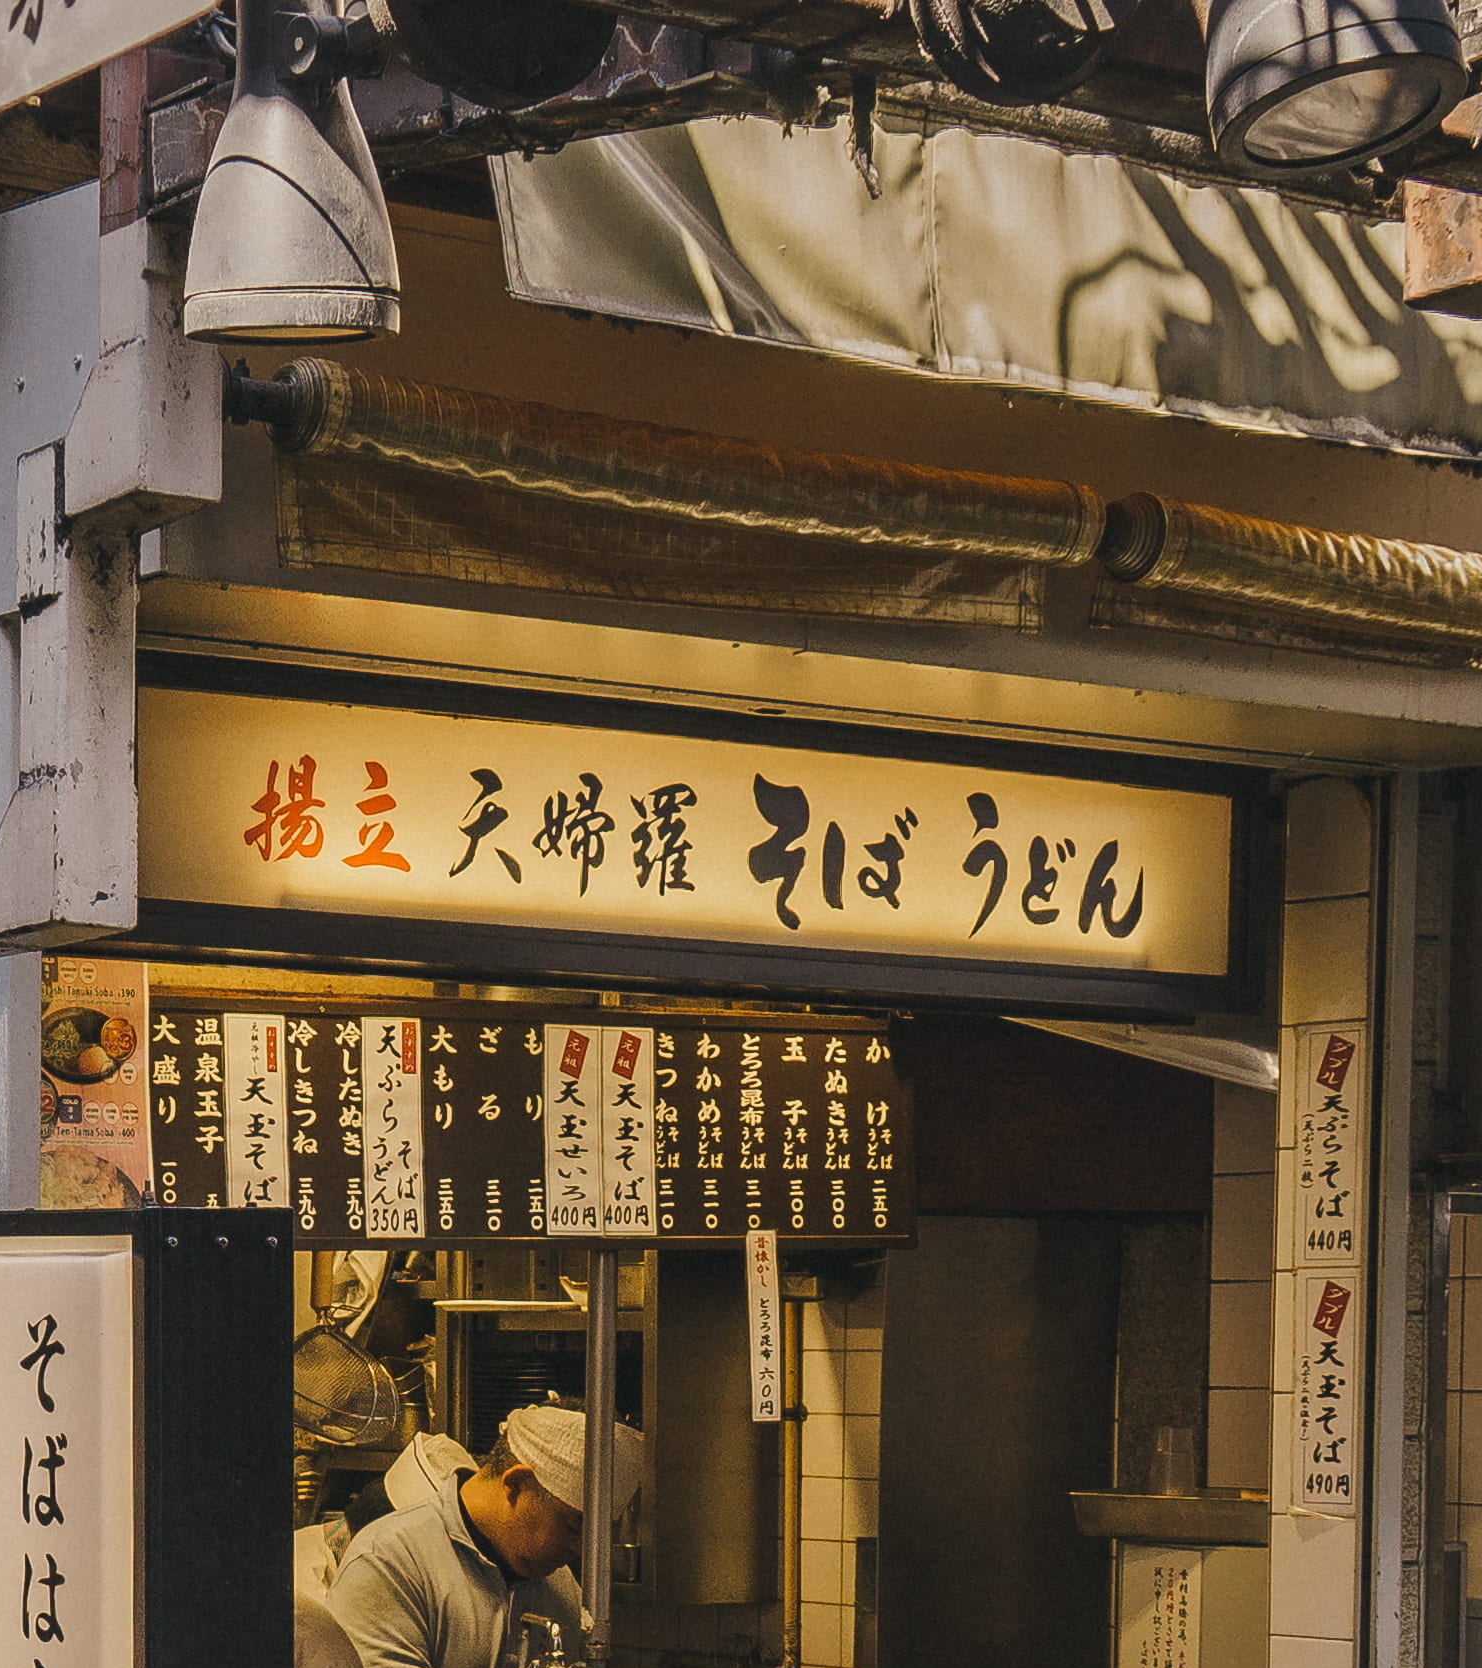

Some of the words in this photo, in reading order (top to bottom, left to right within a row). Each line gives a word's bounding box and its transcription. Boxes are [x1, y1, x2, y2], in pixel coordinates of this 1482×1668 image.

[243, 756, 412, 873] 揚立
[448, 766, 699, 894] 天婦羅
[748, 772, 920, 931] そば
[962, 791, 1145, 940] うどん
[152, 1014, 181, 1126] 大盛り
[194, 1018, 225, 1156] 温泉玉子
[428, 1024, 458, 1130] 大もり
[477, 1026, 502, 1121] ざる
[695, 1033, 722, 1124] わかめ
[738, 1033, 766, 1126] とろろ昆布
[780, 1036, 808, 1126] 玉子
[824, 1037, 848, 1126] たぬき
[865, 1037, 891, 1127] かけ
[610, 1082, 646, 1202] 天玉そば
[1315, 1094, 1351, 1219] 天ぷらそば
[370, 1207, 420, 1235] 350円
[550, 1204, 598, 1229] 400円
[604, 1204, 650, 1227] 400円
[1307, 1228, 1352, 1251] 440円
[1313, 1340, 1348, 1464] 天玉そば
[1305, 1473, 1351, 1497] 490円
